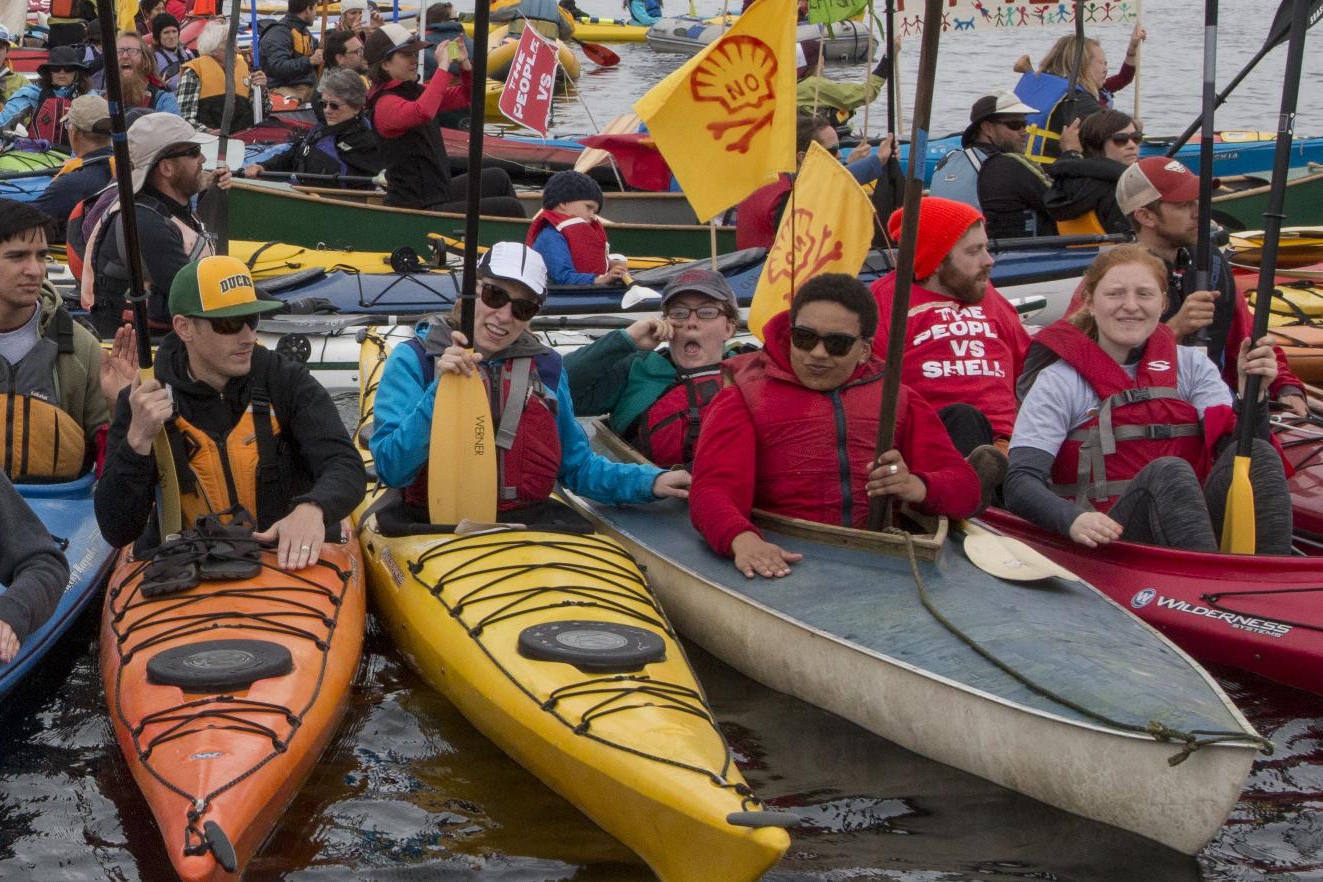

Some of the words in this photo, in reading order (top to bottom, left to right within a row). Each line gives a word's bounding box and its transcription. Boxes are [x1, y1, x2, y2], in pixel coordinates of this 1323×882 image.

[509, 49, 525, 89] THE
[513, 38, 540, 119] PEOPLE
[536, 73, 552, 100] VS
[724, 73, 759, 100] NO
[935, 306, 986, 321] THE
[950, 340, 985, 357] VS
[922, 360, 1005, 378] SHELL
[474, 415, 485, 456] WERNER
[1157, 596, 1293, 634] WILDERNESS
[1232, 623, 1285, 638] SYSTEMS
